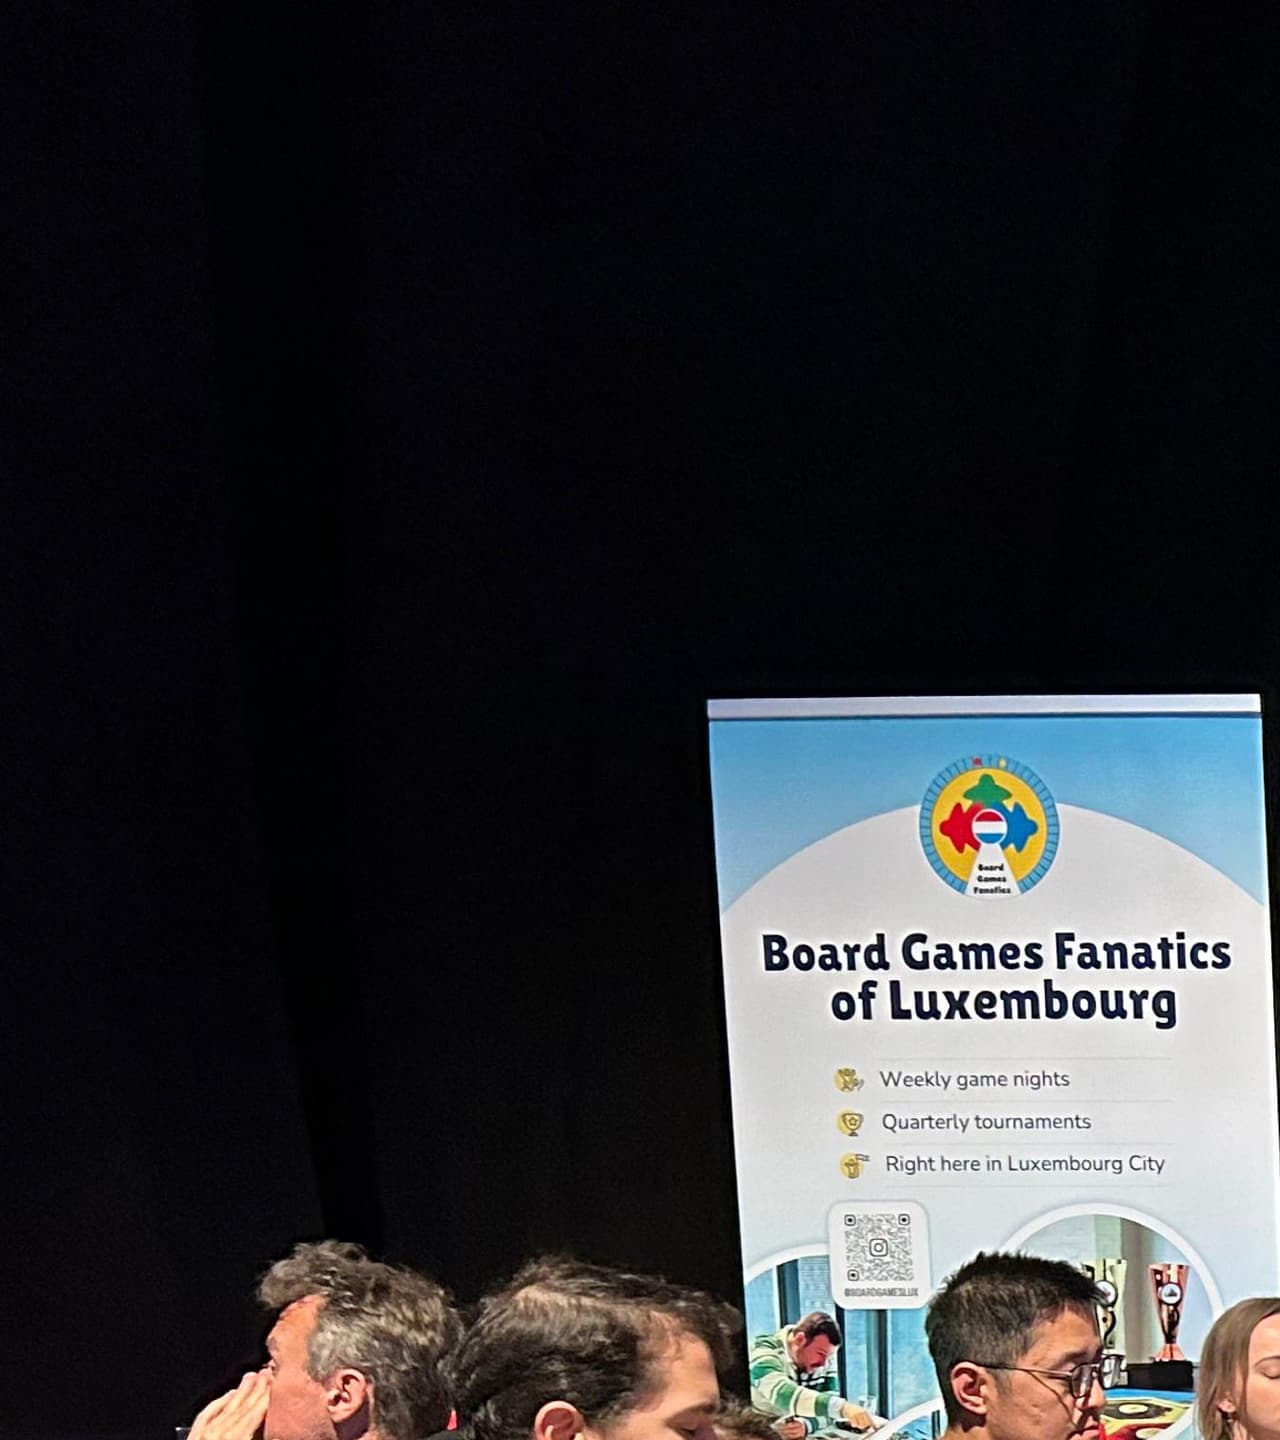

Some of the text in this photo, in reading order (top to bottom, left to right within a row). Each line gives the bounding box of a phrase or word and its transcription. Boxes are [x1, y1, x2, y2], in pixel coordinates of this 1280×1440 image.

[762, 932, 1232, 971] Board Games Fanatics
[831, 980, 1177, 1029] of Luxembourg
[880, 1070, 1070, 1092] Weekly game nights
[881, 1113, 1092, 1135] Quarterly tournaments
[886, 1154, 1166, 1176] Right here in Luxembourg City
